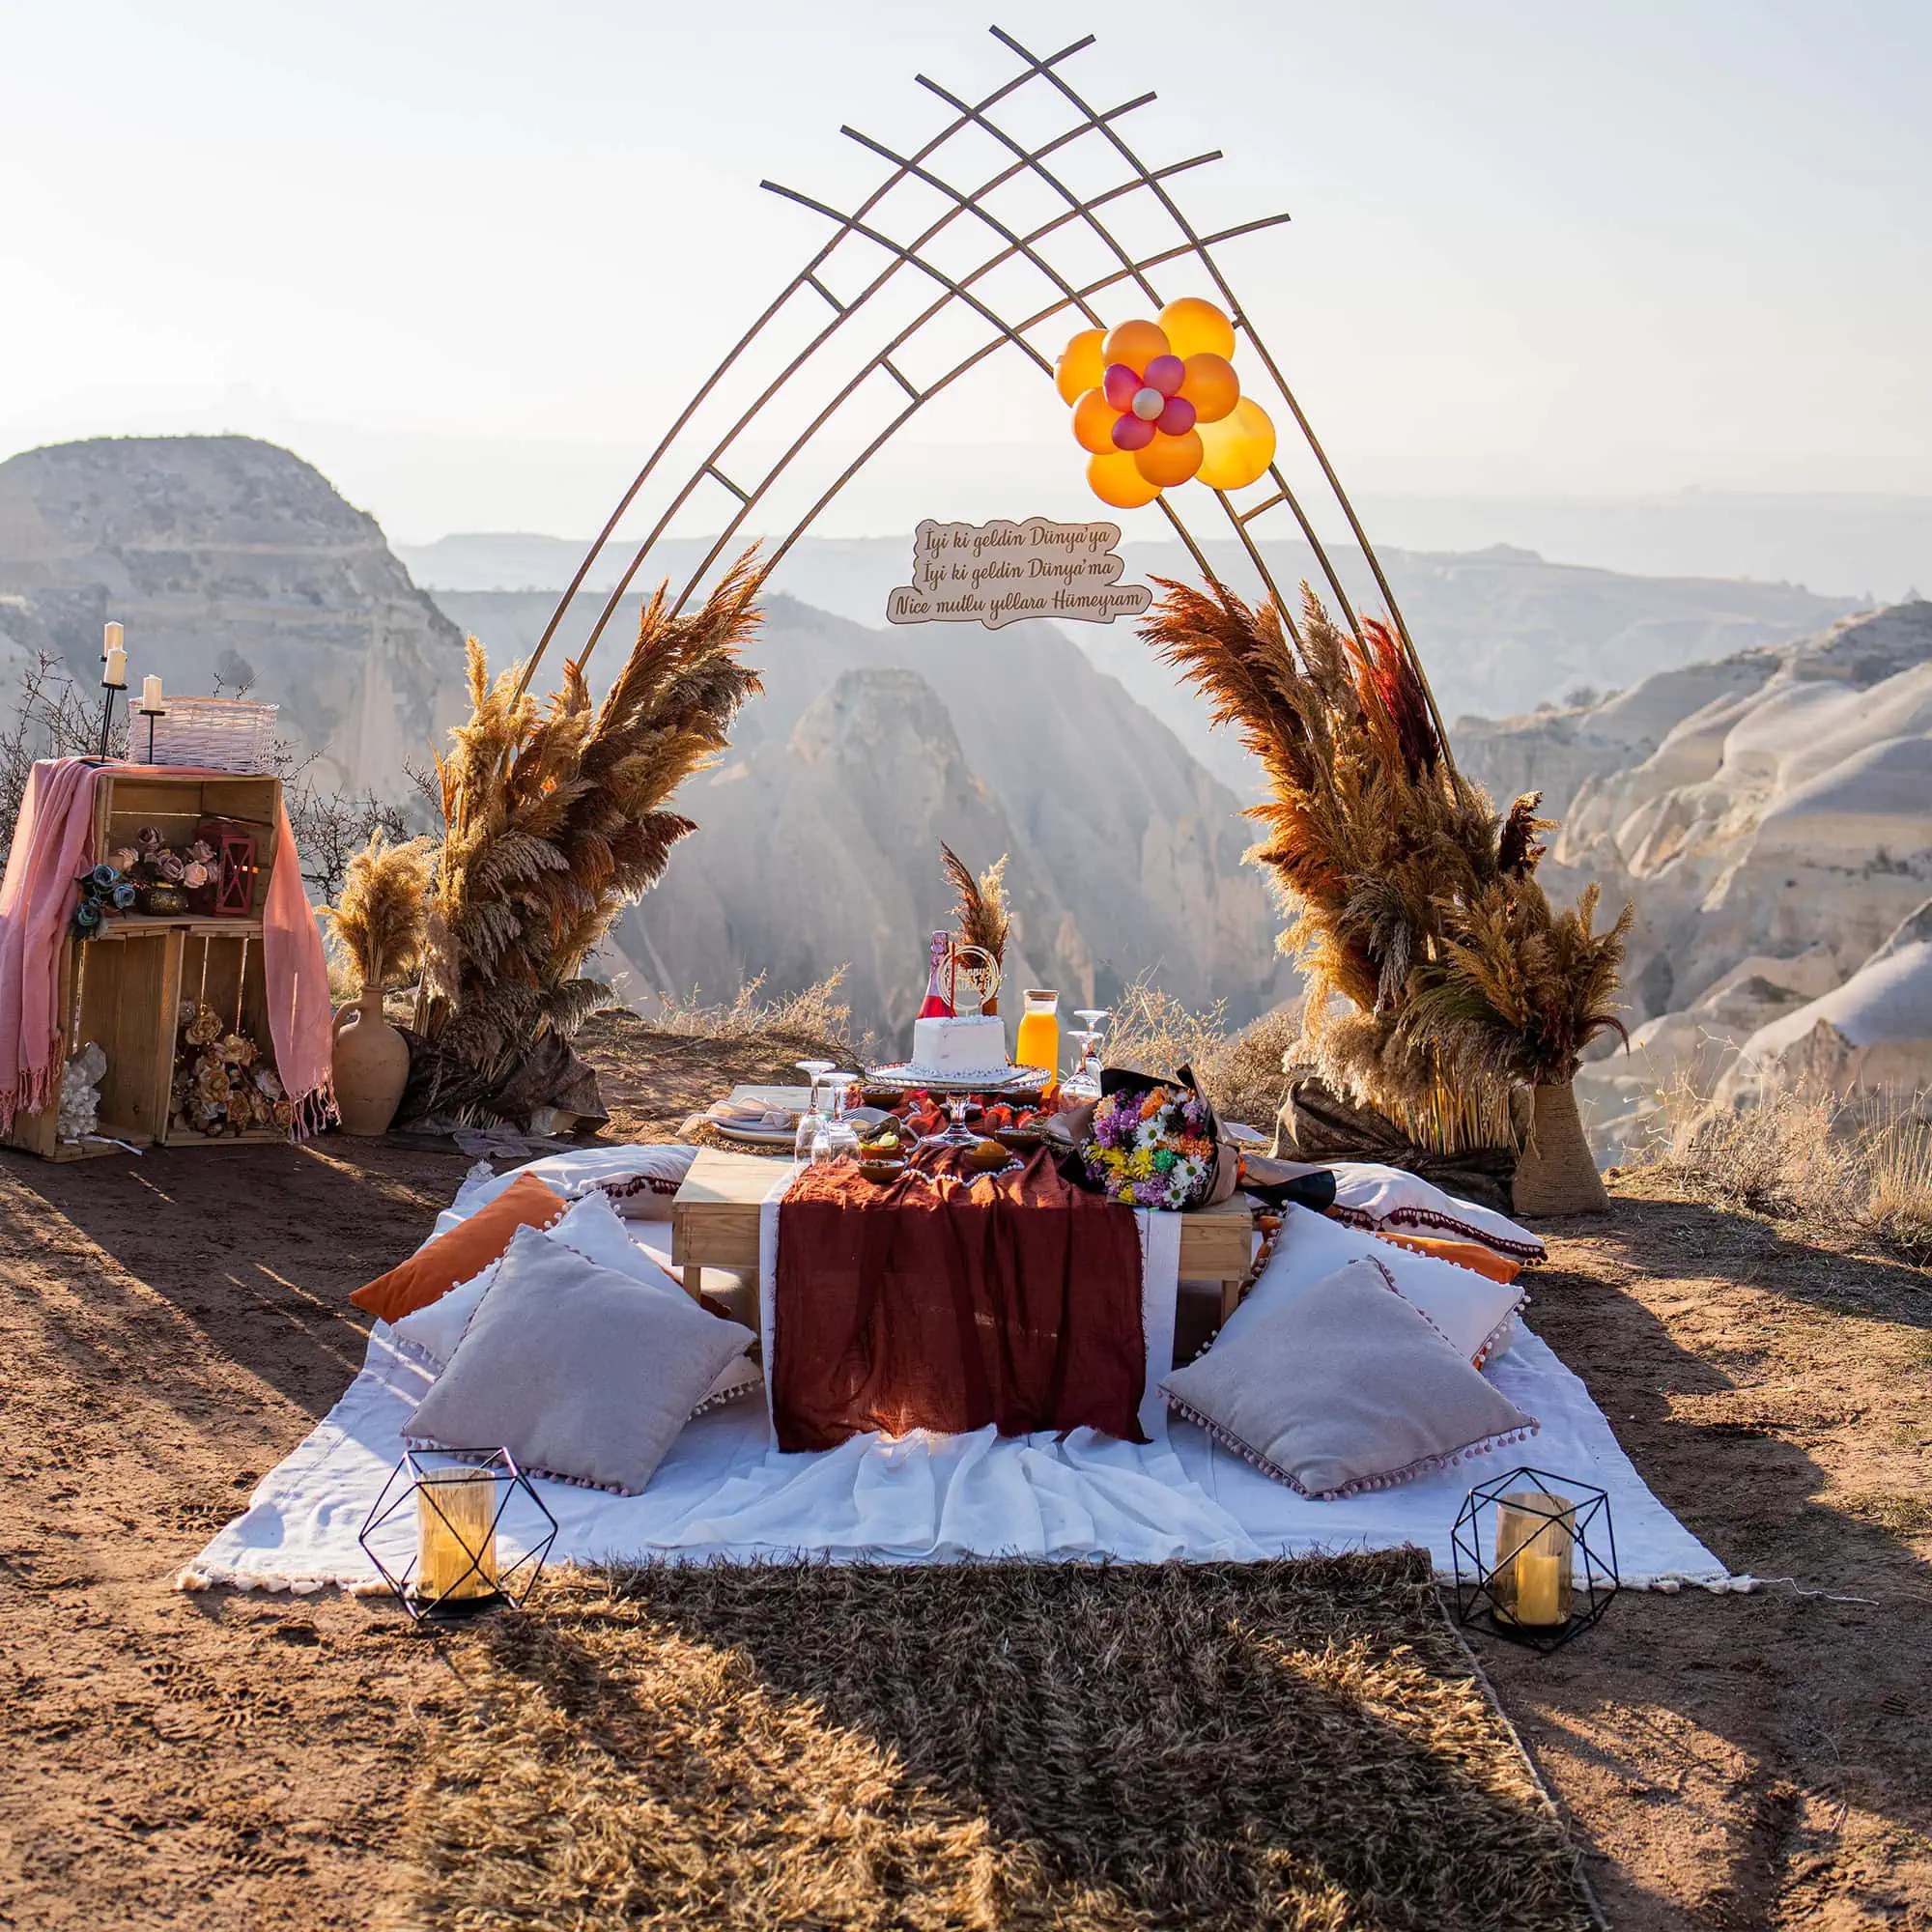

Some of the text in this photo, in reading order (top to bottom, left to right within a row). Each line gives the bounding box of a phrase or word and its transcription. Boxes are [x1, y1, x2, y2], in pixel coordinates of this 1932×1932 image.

[925, 527, 948, 558] İyi
[953, 528, 969, 548] ki
[974, 528, 1025, 556] geldin
[923, 560, 947, 590] İyi
[952, 561, 968, 581] ki
[972, 560, 1024, 588] geldin
[895, 589, 1143, 620] Nice mutlu yıllara Hümeyram
